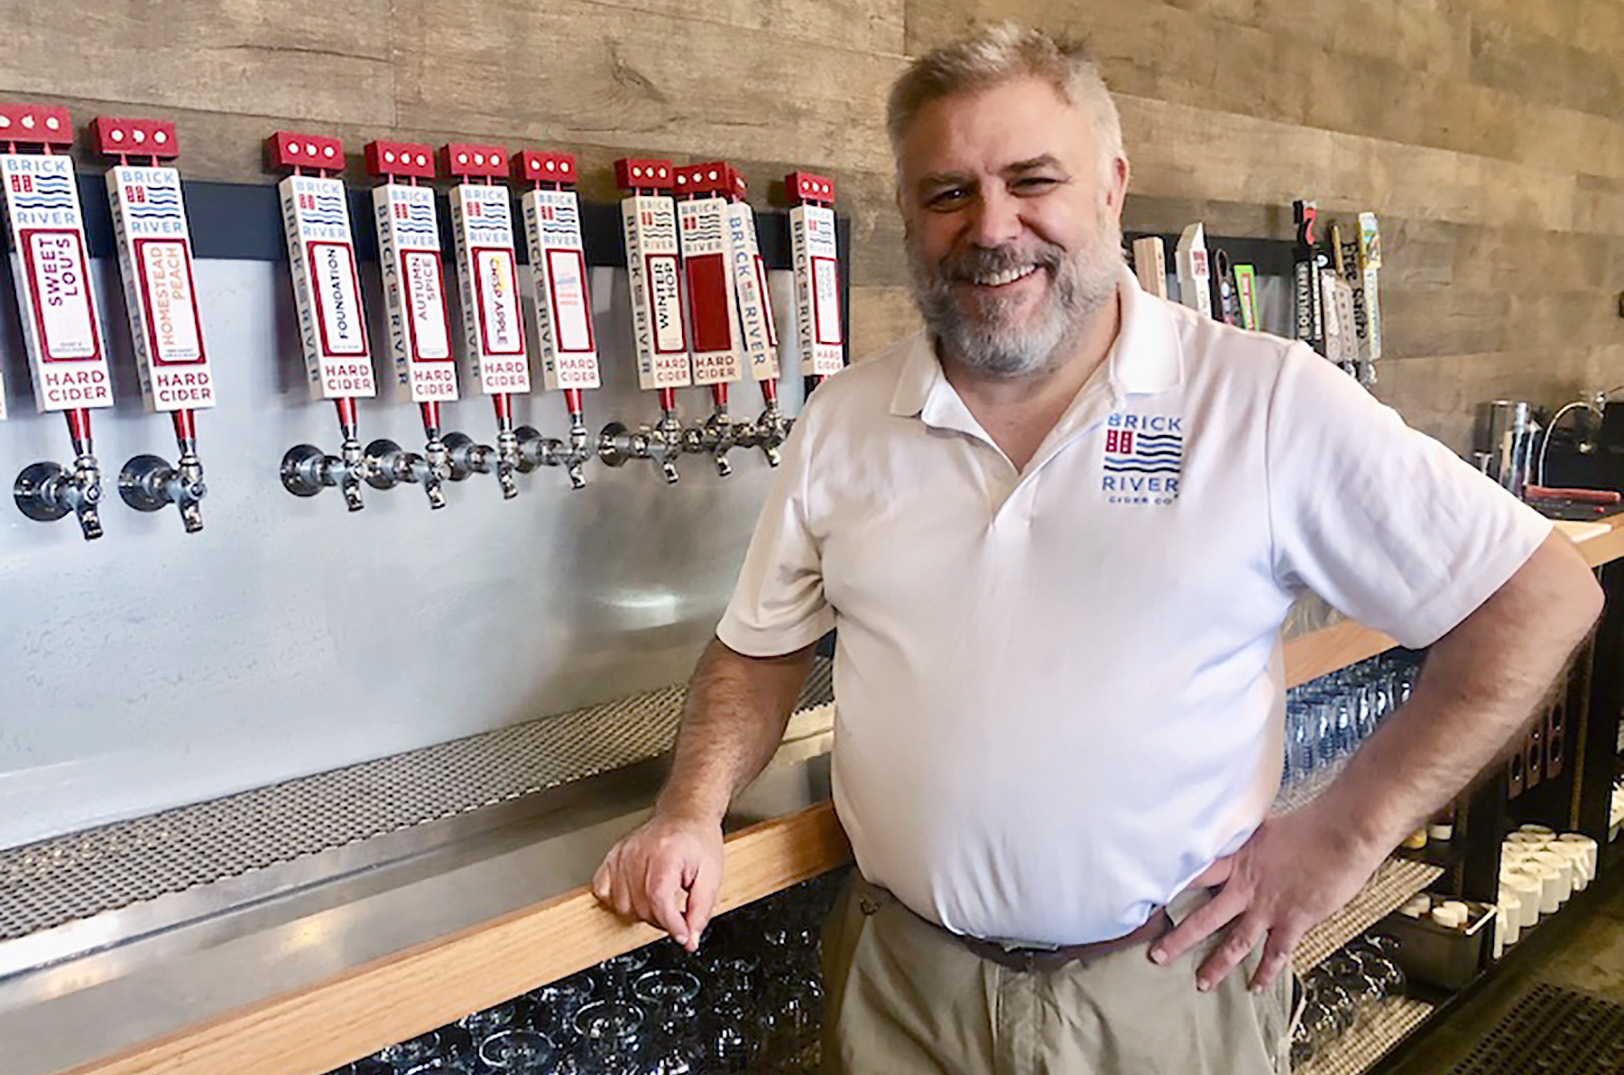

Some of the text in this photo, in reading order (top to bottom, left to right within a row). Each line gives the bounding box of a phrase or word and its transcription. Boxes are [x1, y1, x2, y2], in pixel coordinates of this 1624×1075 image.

[8, 159, 66, 172] BRICK
[122, 171, 174, 184] BRICK
[296, 181, 340, 194] BRICK
[391, 190, 430, 202] BRICK
[464, 189, 505, 200] BRICK
[538, 194, 573, 204] BRICK
[640, 201, 670, 210] BRICK
[681, 203, 720, 214] BRICK
[17, 212, 76, 224] RIVER
[131, 221, 183, 233] RIVER
[303, 227, 346, 239] RIVER
[397, 234, 436, 246] RIVER
[469, 232, 510, 243] RIVER
[544, 235, 578, 245] RIVER
[643, 240, 673, 249] RIVER
[685, 242, 722, 252] RIVER
[39, 238, 63, 306] SWEET
[56, 238, 78, 297] LOU'S
[166, 247, 185, 301] PEACH
[425, 258, 437, 301] SPICE
[284, 197, 319, 382] BRICK RIVER
[327, 248, 349, 339] FOUNDATION
[411, 256, 427, 320] AUTUMN
[626, 215, 650, 374] BRICK RIVER
[729, 216, 766, 366] BRICK RIVER
[794, 221, 813, 361] BRICK RIVER
[150, 246, 175, 346] HOMESTEAD
[377, 205, 408, 385] BRICK RIVER
[653, 263, 669, 330] WINTER
[494, 301, 508, 345] APPLE
[465, 311, 480, 377] RIVER
[538, 308, 554, 372] RIVER
[695, 355, 734, 367] HARD
[816, 351, 841, 361] HARD
[484, 362, 525, 373] HARD
[560, 359, 595, 370] HARD
[655, 359, 687, 368] HARD
[325, 364, 370, 377] HARD
[413, 370, 453, 382] HARD
[561, 372, 596, 382] CIDER
[657, 371, 688, 381] CIDER
[696, 367, 736, 378] CIDER
[45, 370, 105, 386] HARD
[157, 372, 209, 387] HARD
[327, 378, 372, 391] CIDER
[486, 375, 526, 387] CIDER
[48, 386, 107, 402] CIDER
[159, 388, 212, 402] CIDER
[416, 383, 454, 395] CIDER
[1107, 413, 1182, 431] BRICK
[1102, 476, 1179, 492] RIVER
